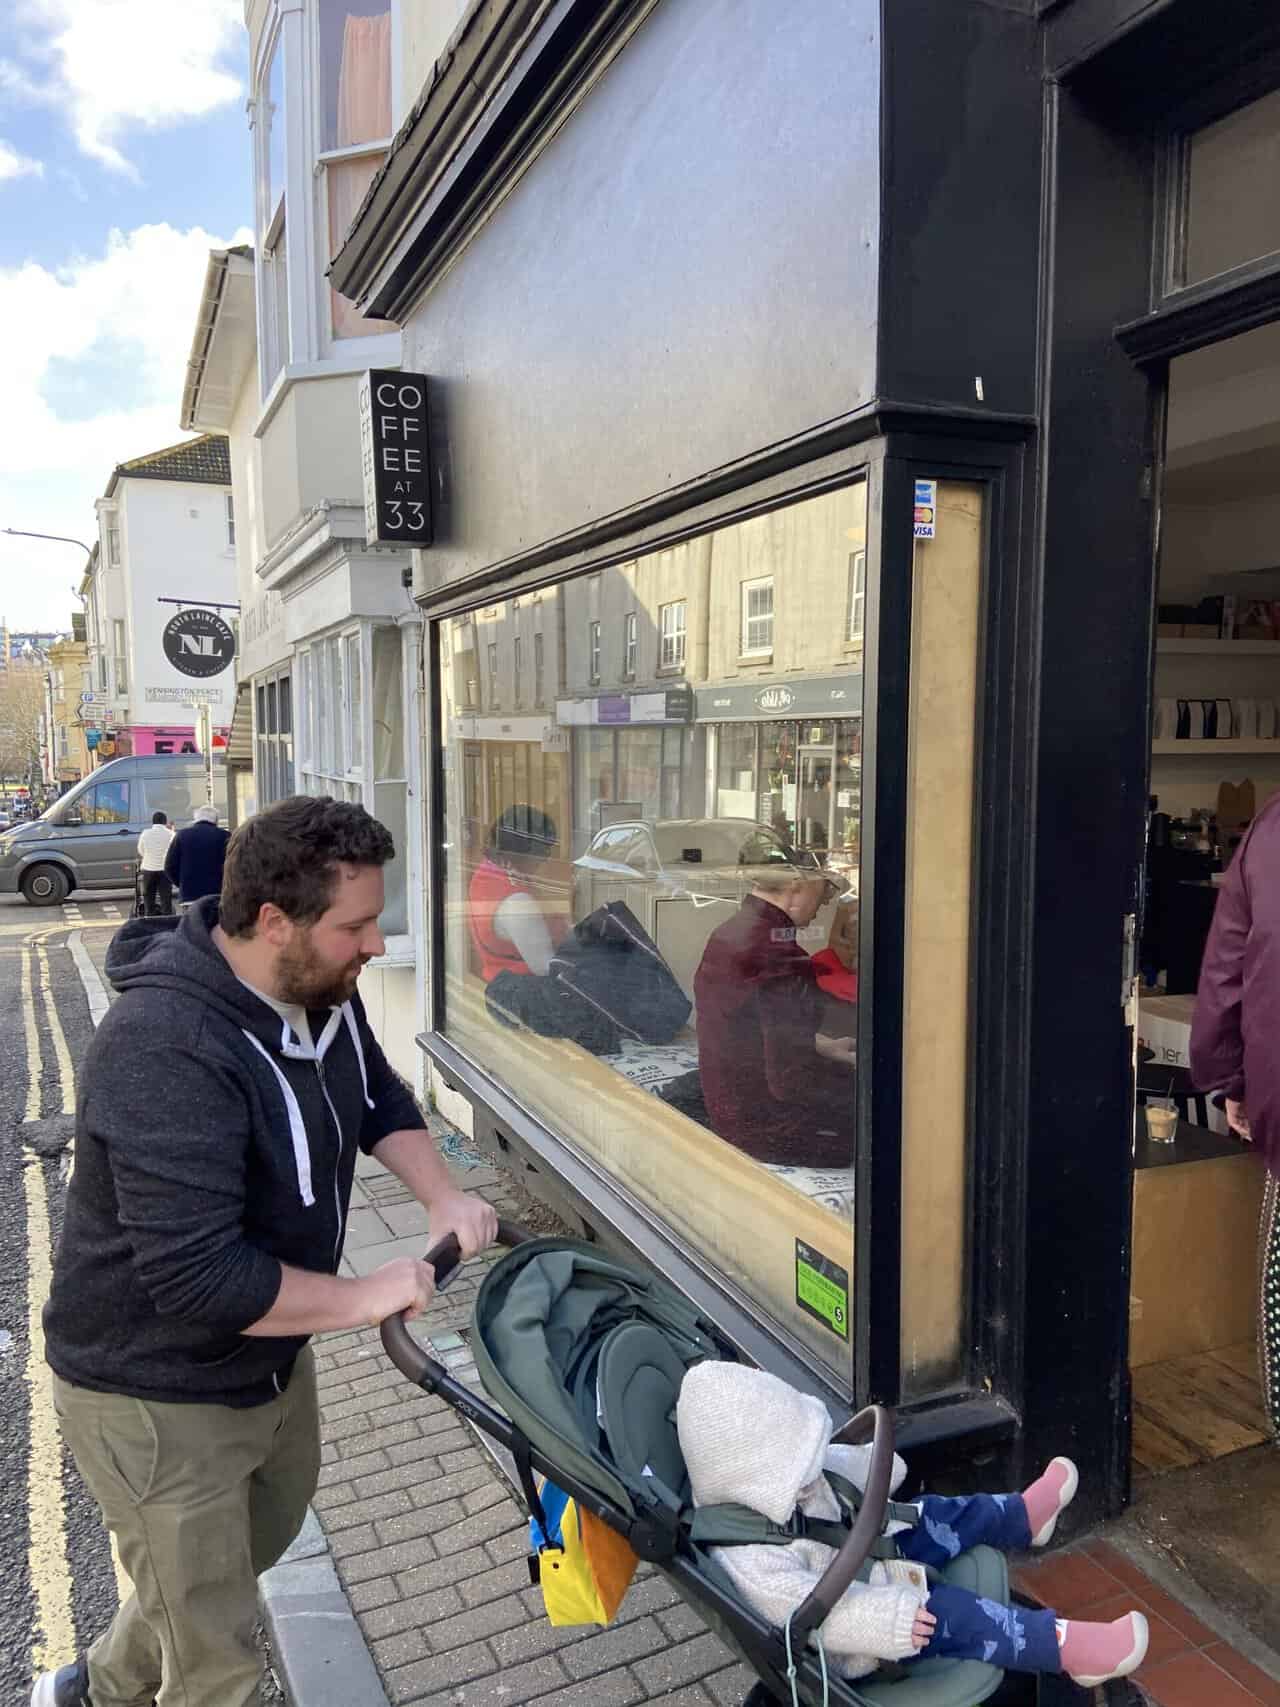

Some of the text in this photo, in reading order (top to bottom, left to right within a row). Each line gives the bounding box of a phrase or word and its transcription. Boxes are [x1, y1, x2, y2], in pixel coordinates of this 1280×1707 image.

[377, 383, 422, 409] CO
[381, 415, 420, 440] FF
[383, 447, 421, 473] EE
[394, 480, 412, 493] AT
[385, 500, 425, 530] 33
[914, 527, 933, 536] VISA
[190, 612, 215, 624] LAINE
[178, 633, 222, 657] NL
